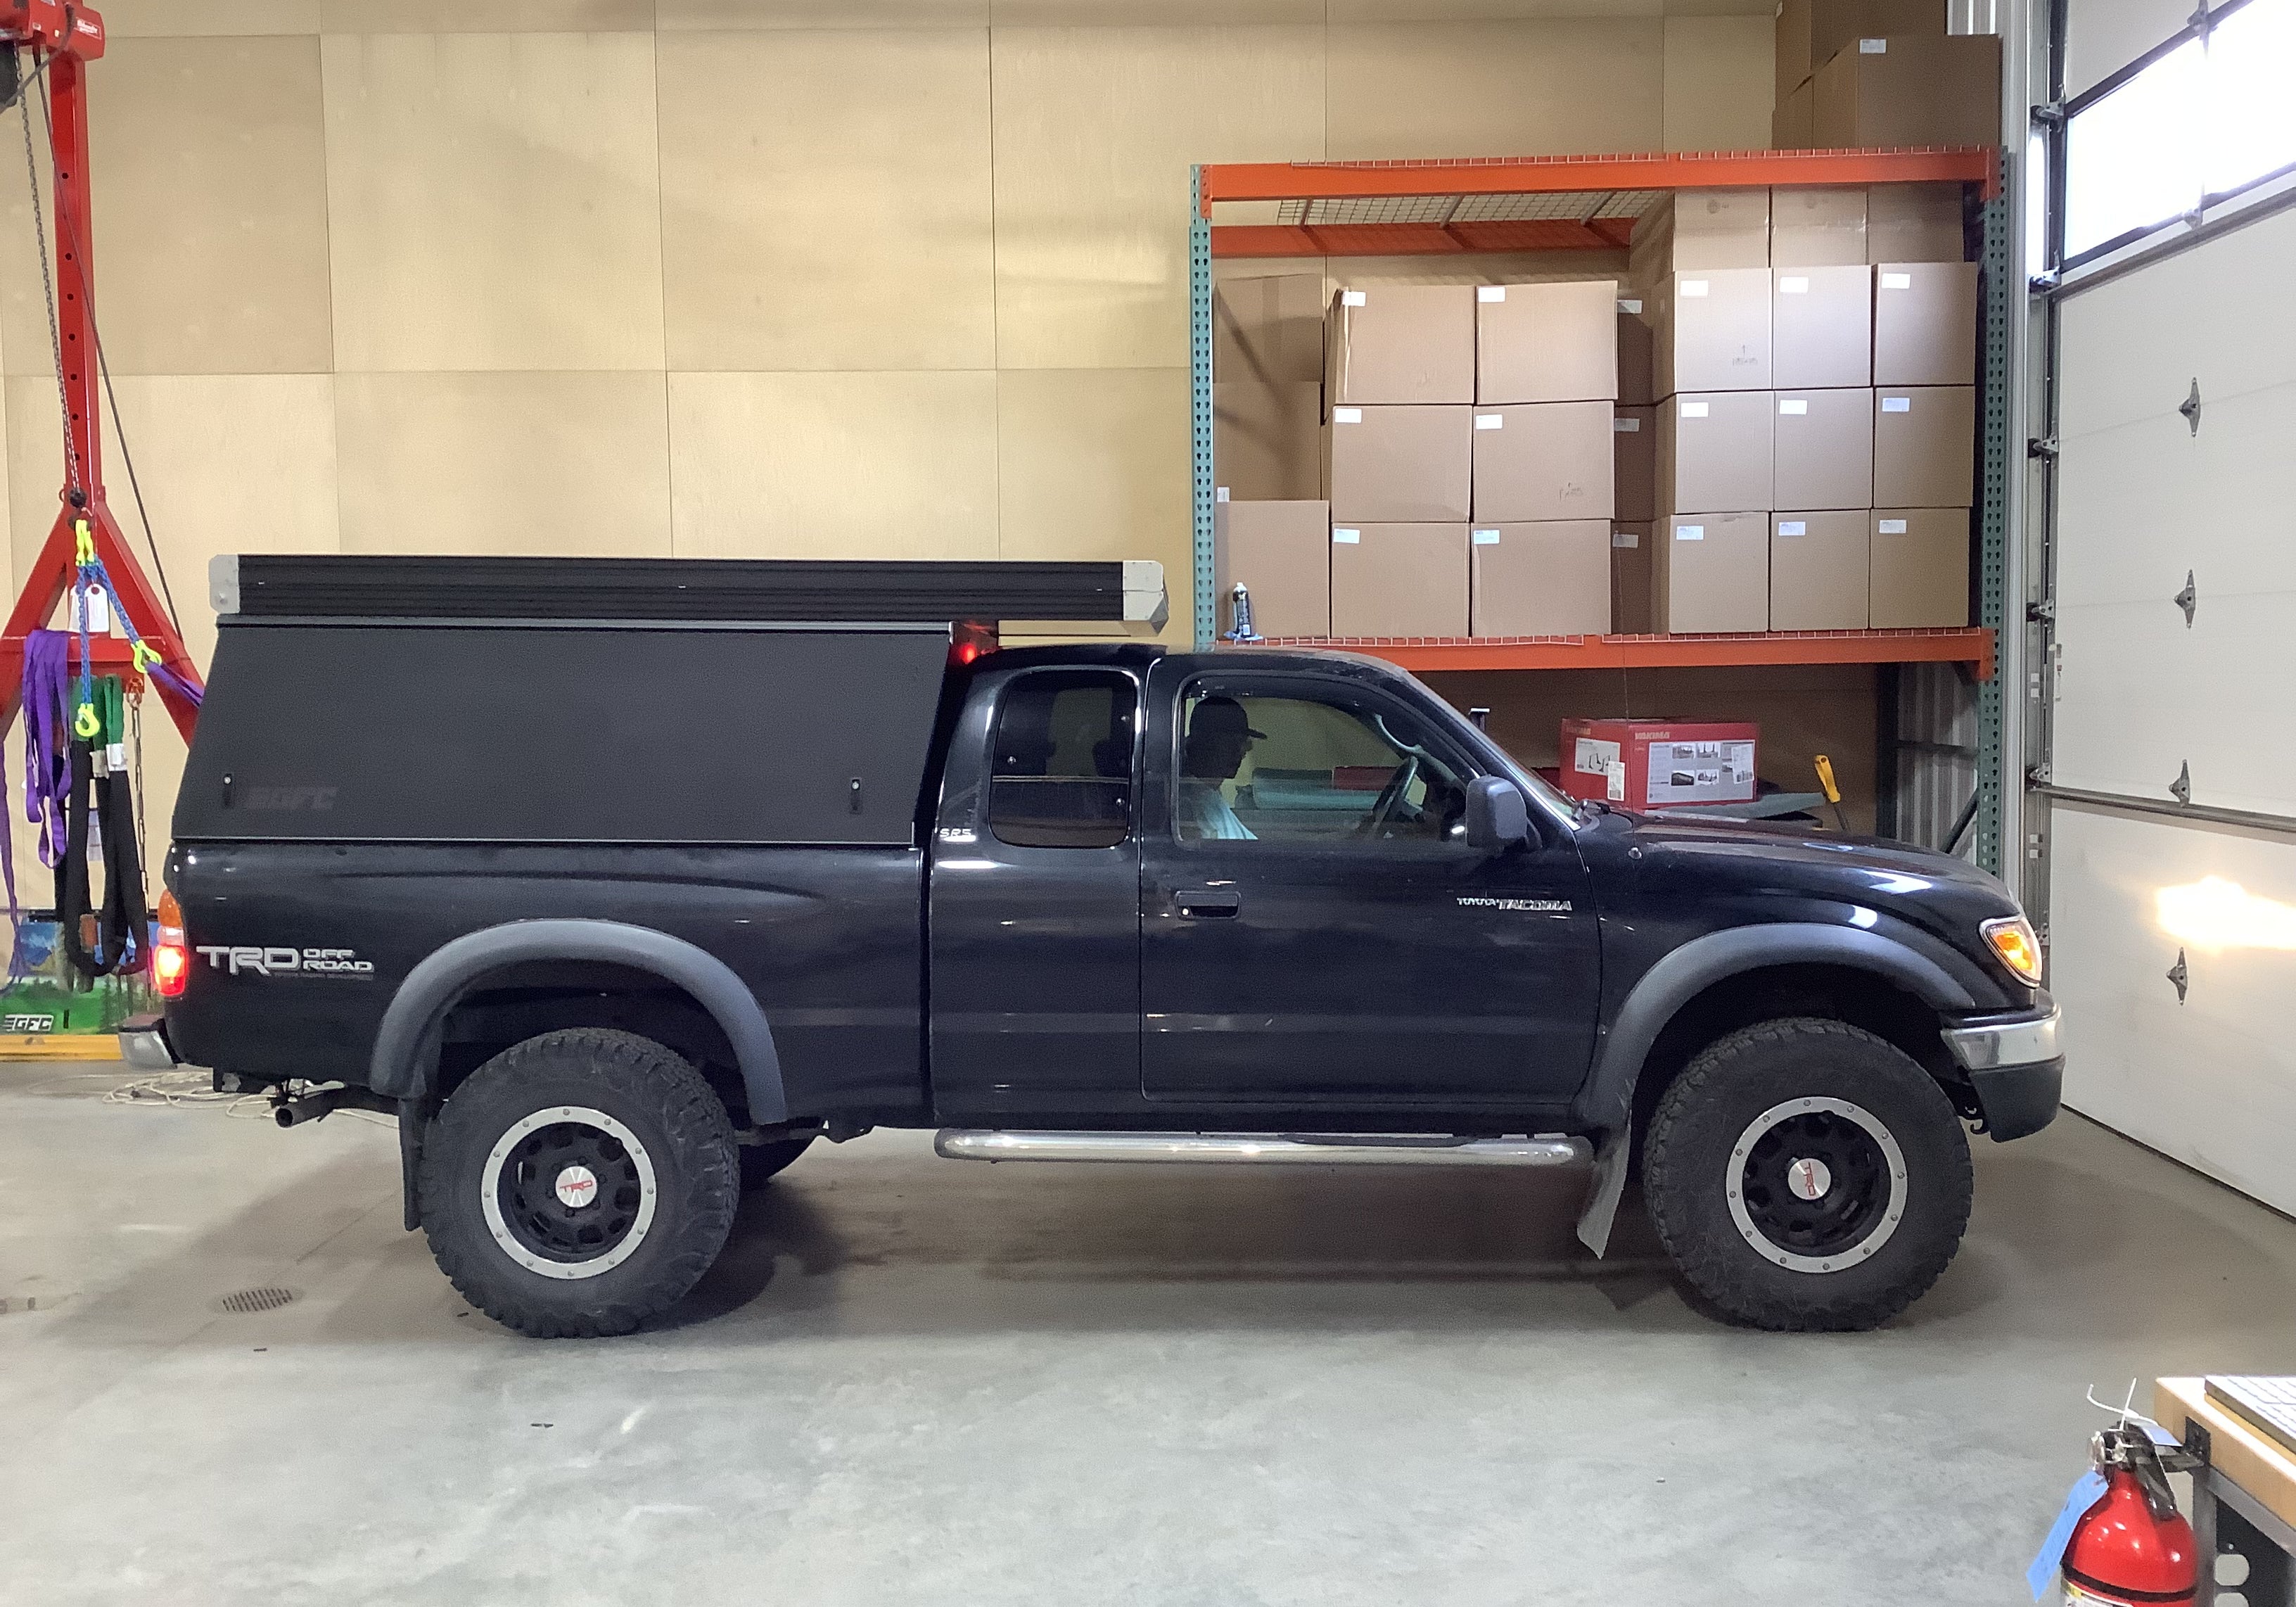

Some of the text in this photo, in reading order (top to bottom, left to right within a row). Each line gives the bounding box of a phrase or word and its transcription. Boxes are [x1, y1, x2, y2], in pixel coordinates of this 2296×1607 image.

[939, 828, 971, 837] SR5
[1497, 898, 1572, 911] TACOMA
[196, 946, 300, 975] TRD
[302, 948, 355, 960] OFF
[302, 960, 374, 972] ROAD
[1802, 1162, 1816, 1196] TRD
[559, 1179, 593, 1193] TRD
